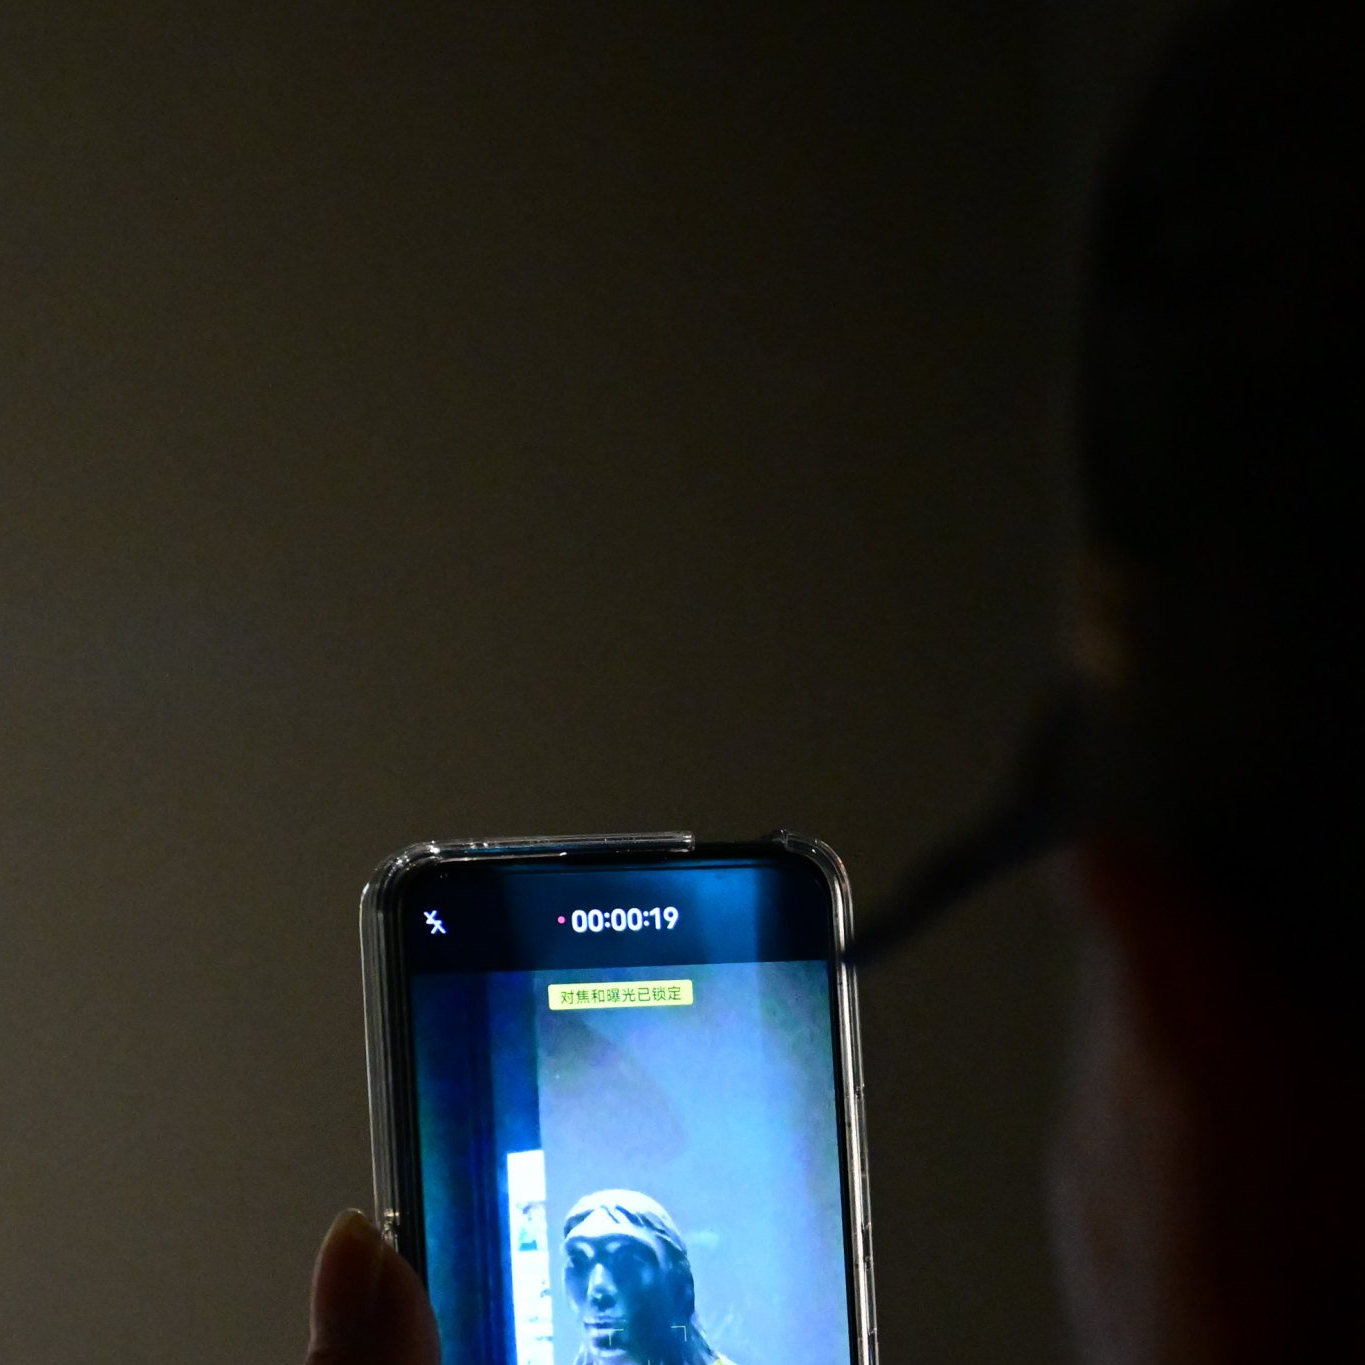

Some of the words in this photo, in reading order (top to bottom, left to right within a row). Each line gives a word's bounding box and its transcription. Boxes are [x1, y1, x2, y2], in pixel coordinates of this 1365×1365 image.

[571, 906, 679, 933] 00:00:19
[560, 985, 682, 1005] 对焦和曝光已锁定
